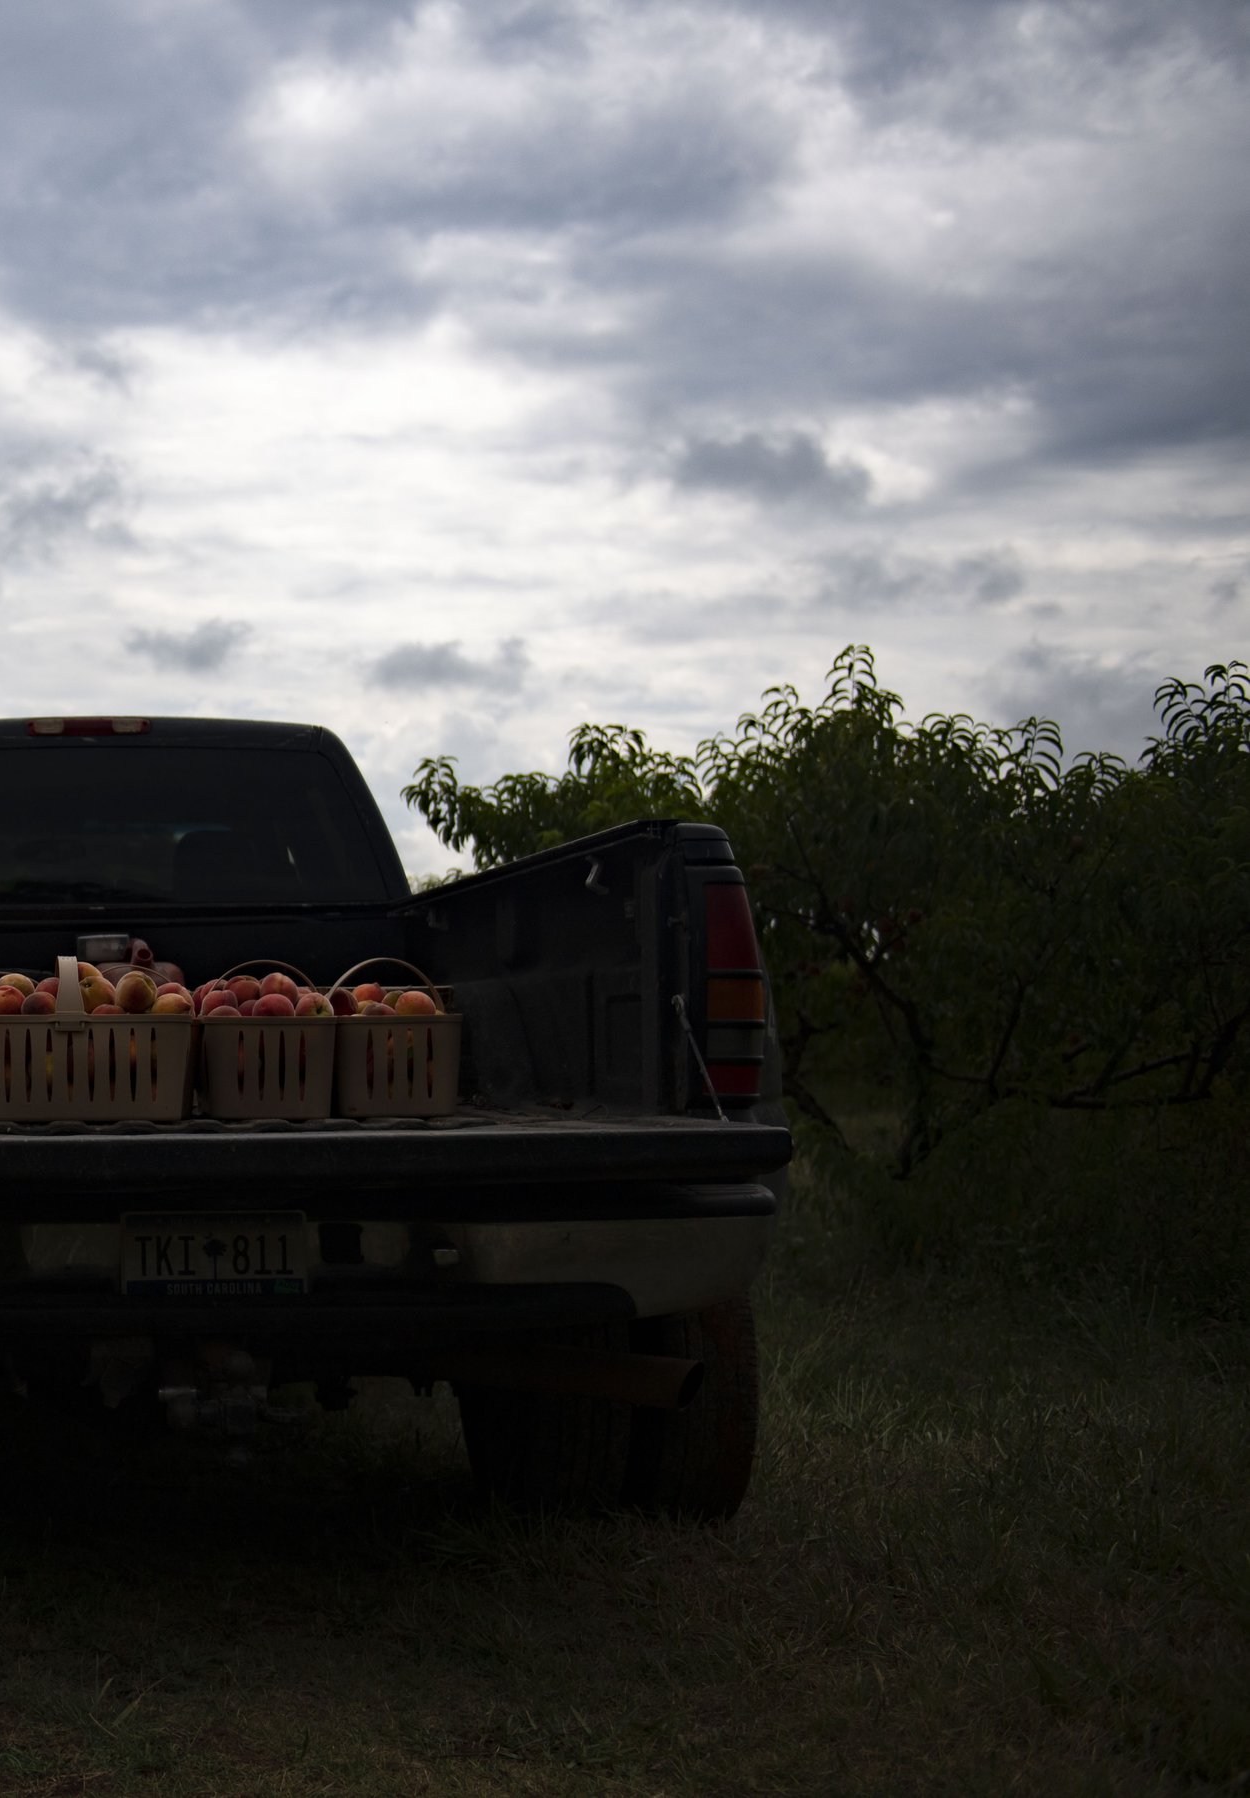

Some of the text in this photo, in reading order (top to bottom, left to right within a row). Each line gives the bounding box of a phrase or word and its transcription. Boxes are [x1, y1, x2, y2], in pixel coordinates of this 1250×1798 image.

[134, 1234, 294, 1276] TKI 811
[166, 1282, 203, 1296] SOUTH
[206, 1282, 263, 1296] CAROLINA
